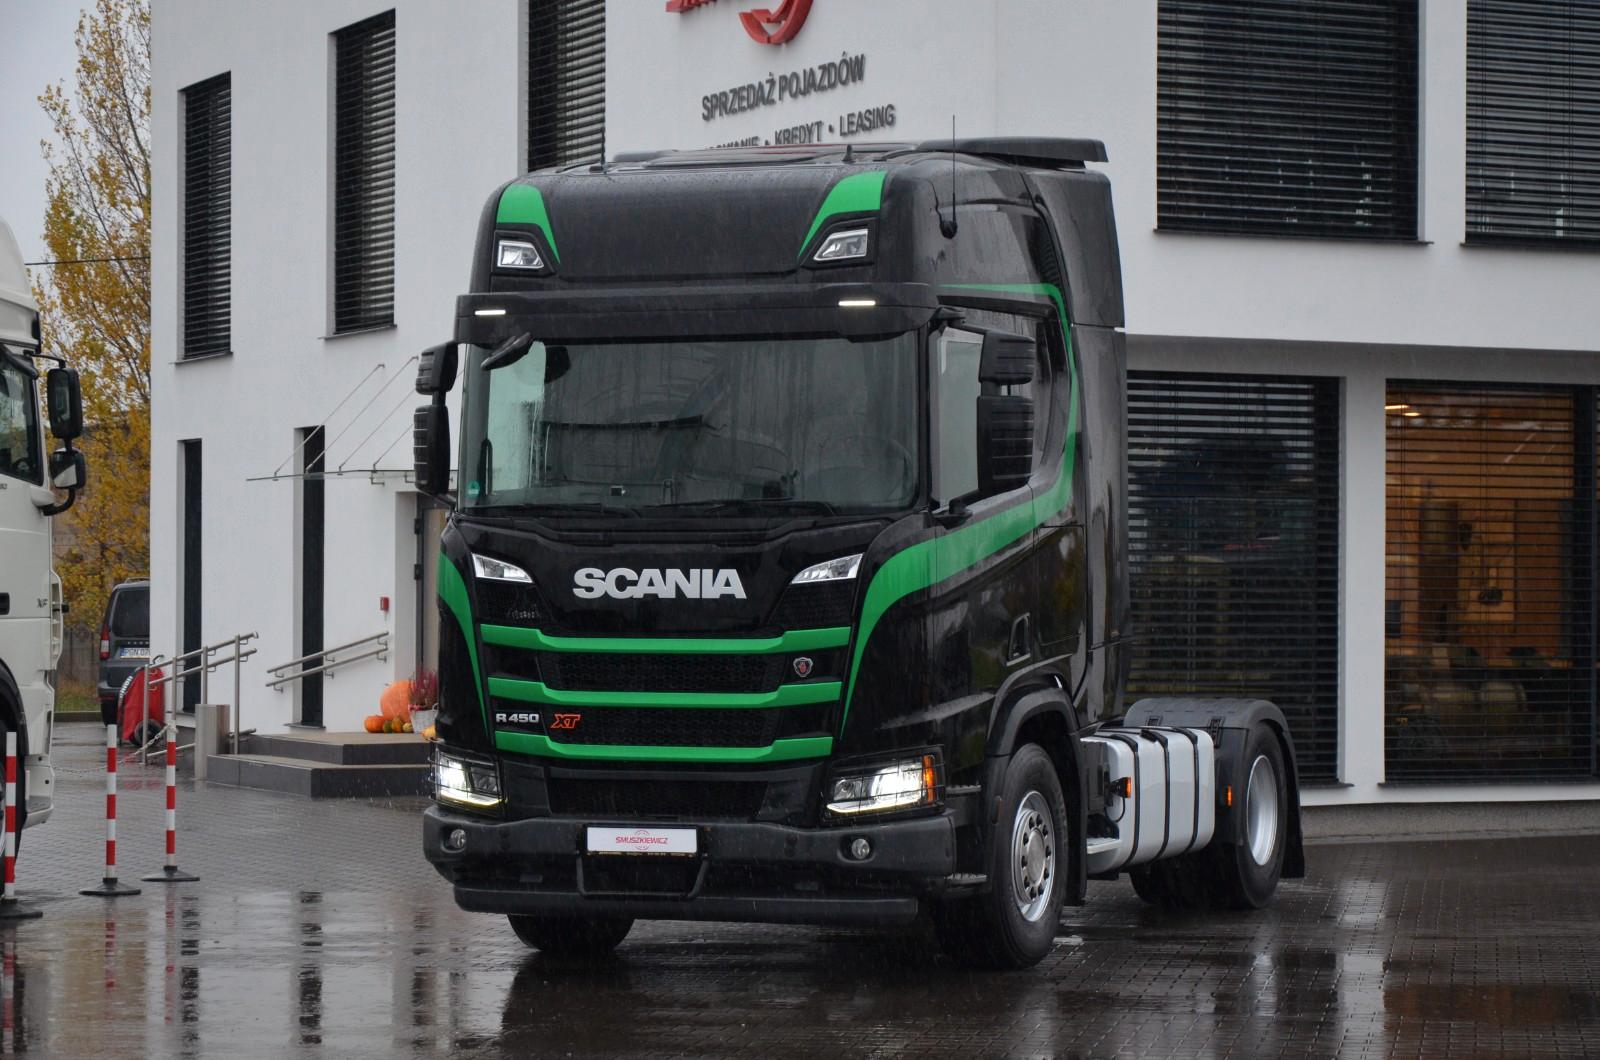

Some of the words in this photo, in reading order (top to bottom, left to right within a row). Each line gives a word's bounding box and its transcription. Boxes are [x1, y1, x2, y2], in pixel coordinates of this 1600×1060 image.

[702, 71, 777, 121] SPRZEDAŻ
[778, 51, 865, 101] POJAZDÓW
[774, 120, 823, 145] KREDYT
[839, 104, 895, 137] LEASING
[572, 566, 747, 600] SCANIA
[550, 713, 581, 729] XT
[615, 836, 669, 845] SMUSZKIEWICZ
